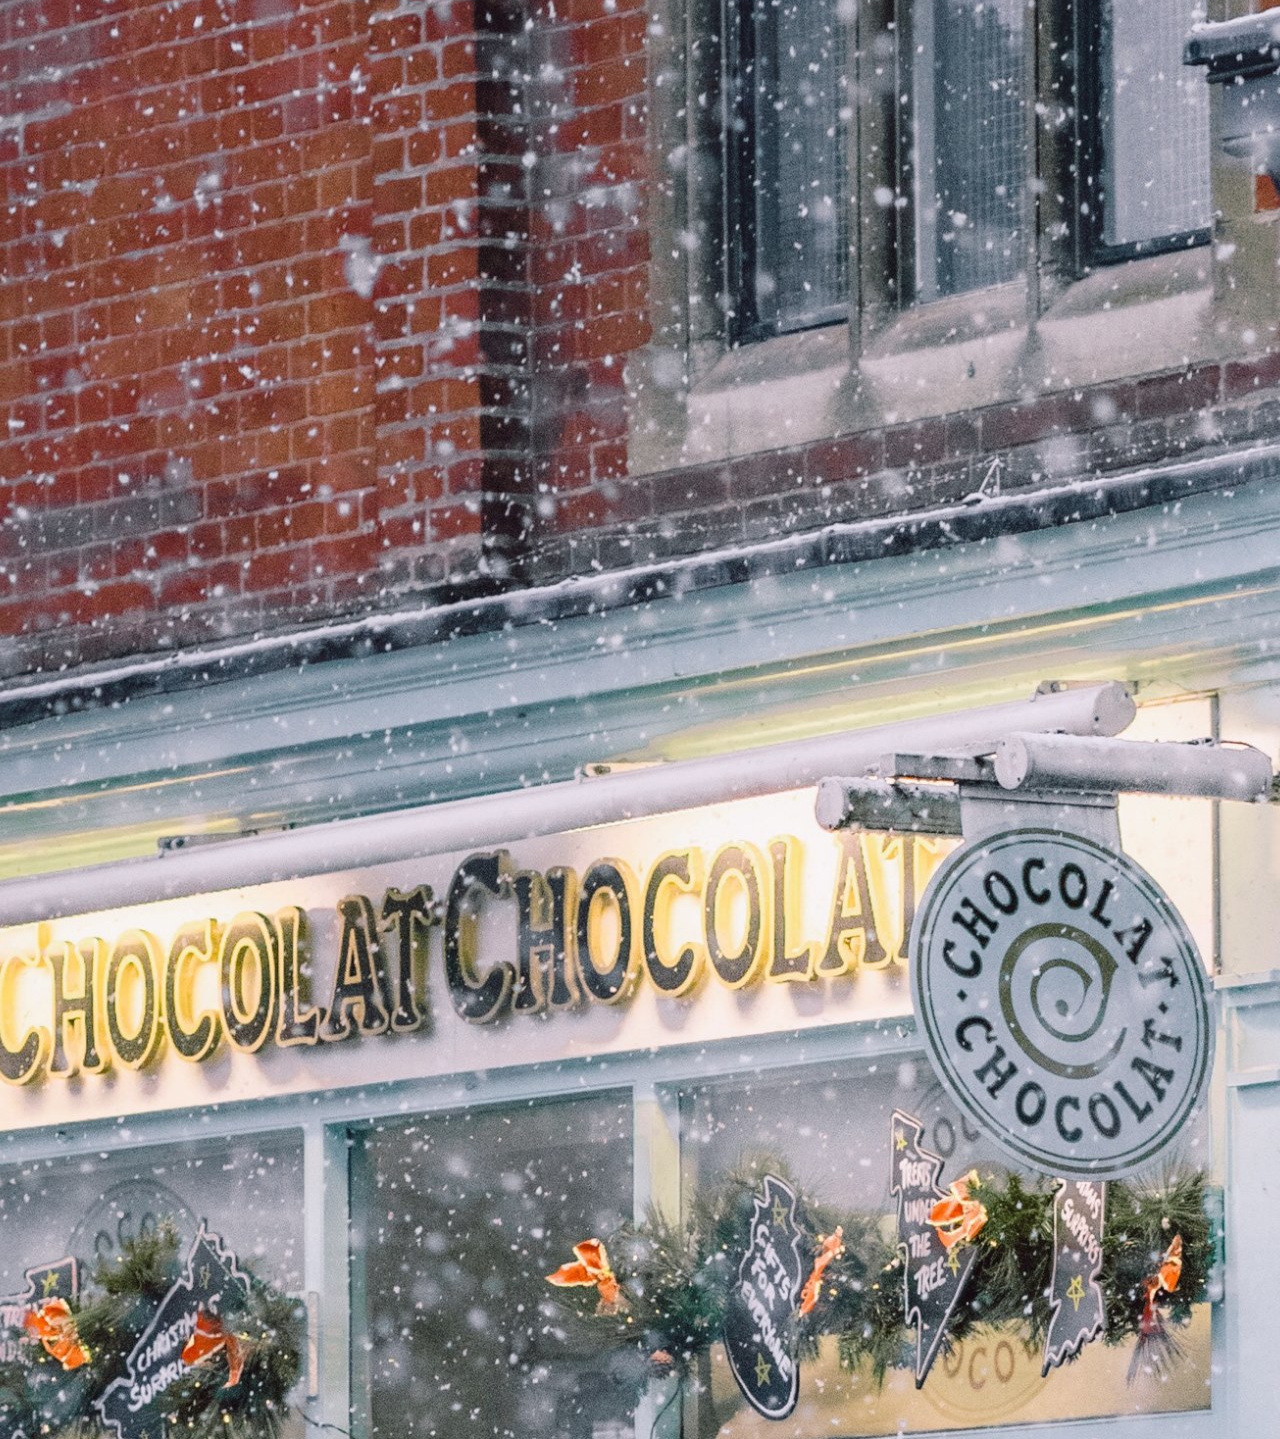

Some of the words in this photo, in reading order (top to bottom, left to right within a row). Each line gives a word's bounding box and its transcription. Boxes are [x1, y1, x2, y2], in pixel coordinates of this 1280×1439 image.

[444, 833, 942, 1025] CHOCOLAT
[942, 857, 1180, 989] CHOCOLAT
[955, 1015, 1183, 1143] CHOCOLAT
[909, 1231, 931, 1258] THE
[914, 1256, 946, 1295] TREE
